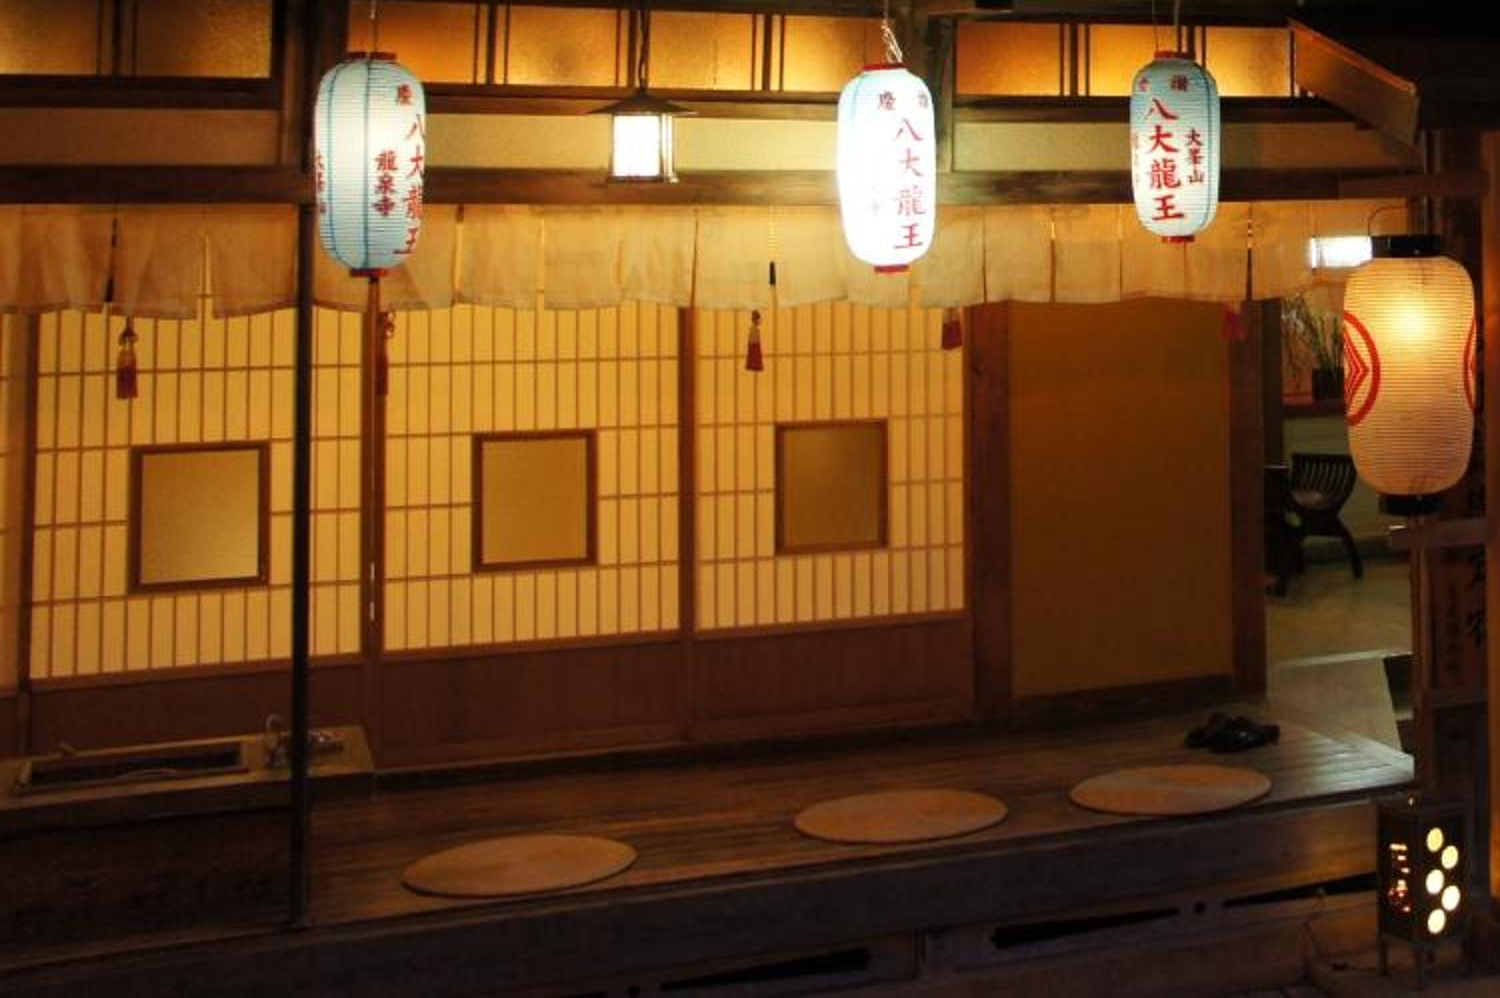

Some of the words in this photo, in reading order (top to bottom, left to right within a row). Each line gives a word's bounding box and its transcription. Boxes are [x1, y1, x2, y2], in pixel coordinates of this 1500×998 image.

[372, 149, 399, 217] 龍泉寺
[894, 117, 927, 250] 八大龍王
[1145, 98, 1185, 222] 八大龍王
